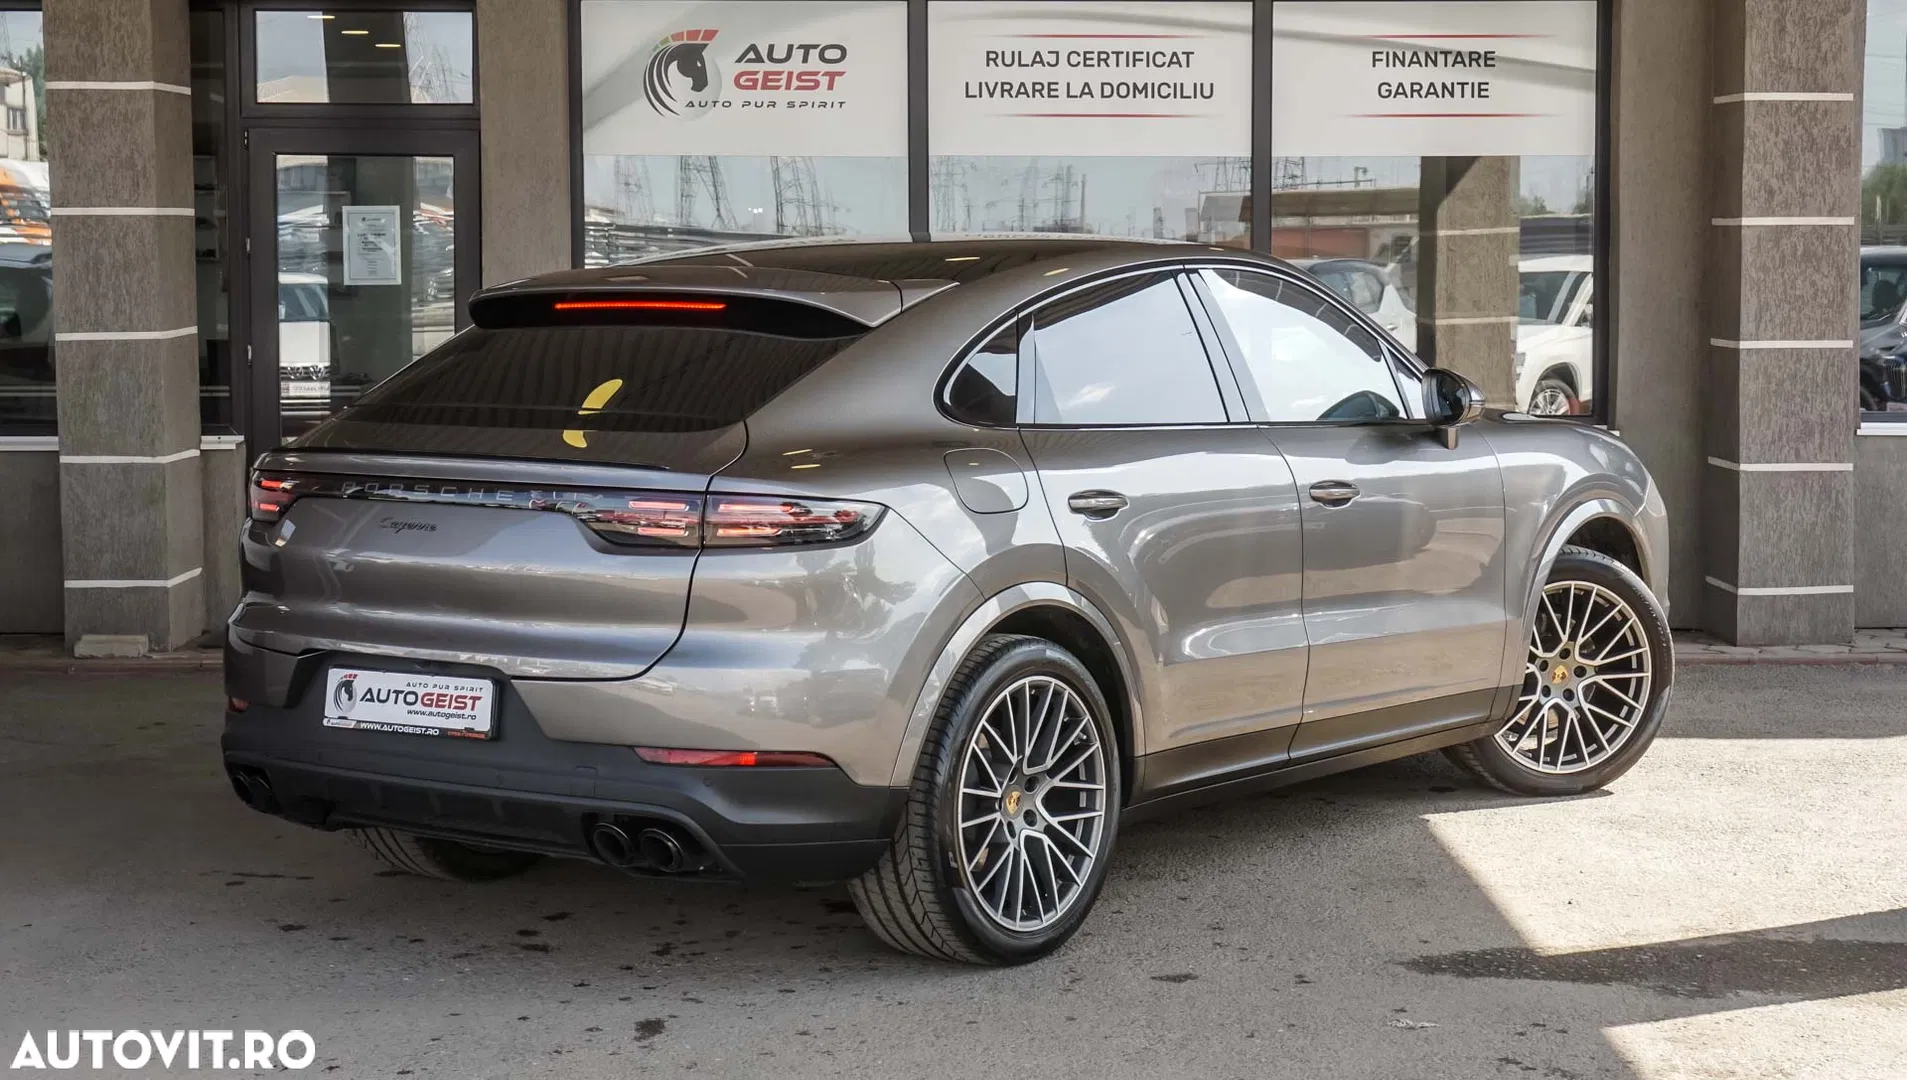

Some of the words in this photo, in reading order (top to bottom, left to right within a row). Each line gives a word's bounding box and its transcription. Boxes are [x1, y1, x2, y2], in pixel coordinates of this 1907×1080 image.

[734, 43, 847, 64] AUTO
[985, 50, 1060, 67] RULAJ
[1066, 50, 1195, 68] CERTIFICAT
[1372, 50, 1496, 68] FINANTARE
[733, 70, 847, 91] GEIST
[965, 81, 1060, 98] LIVRARE
[1066, 82, 1095, 98] LA
[1100, 82, 1215, 99] DOMICILIU
[1377, 81, 1490, 99] GARANTIE
[685, 100, 732, 108] AUTO
[741, 100, 777, 109] PUR
[786, 100, 846, 109] SPIRIT
[341, 481, 514, 501] PORSCHE
[405, 681, 429, 689] AUTO
[432, 683, 450, 691] PUR
[453, 685, 484, 693] SPIRIT
[406, 708, 477, 721] www.autogeist.ro
[359, 721, 440, 736] WWW.AUTOGEIST.RO
